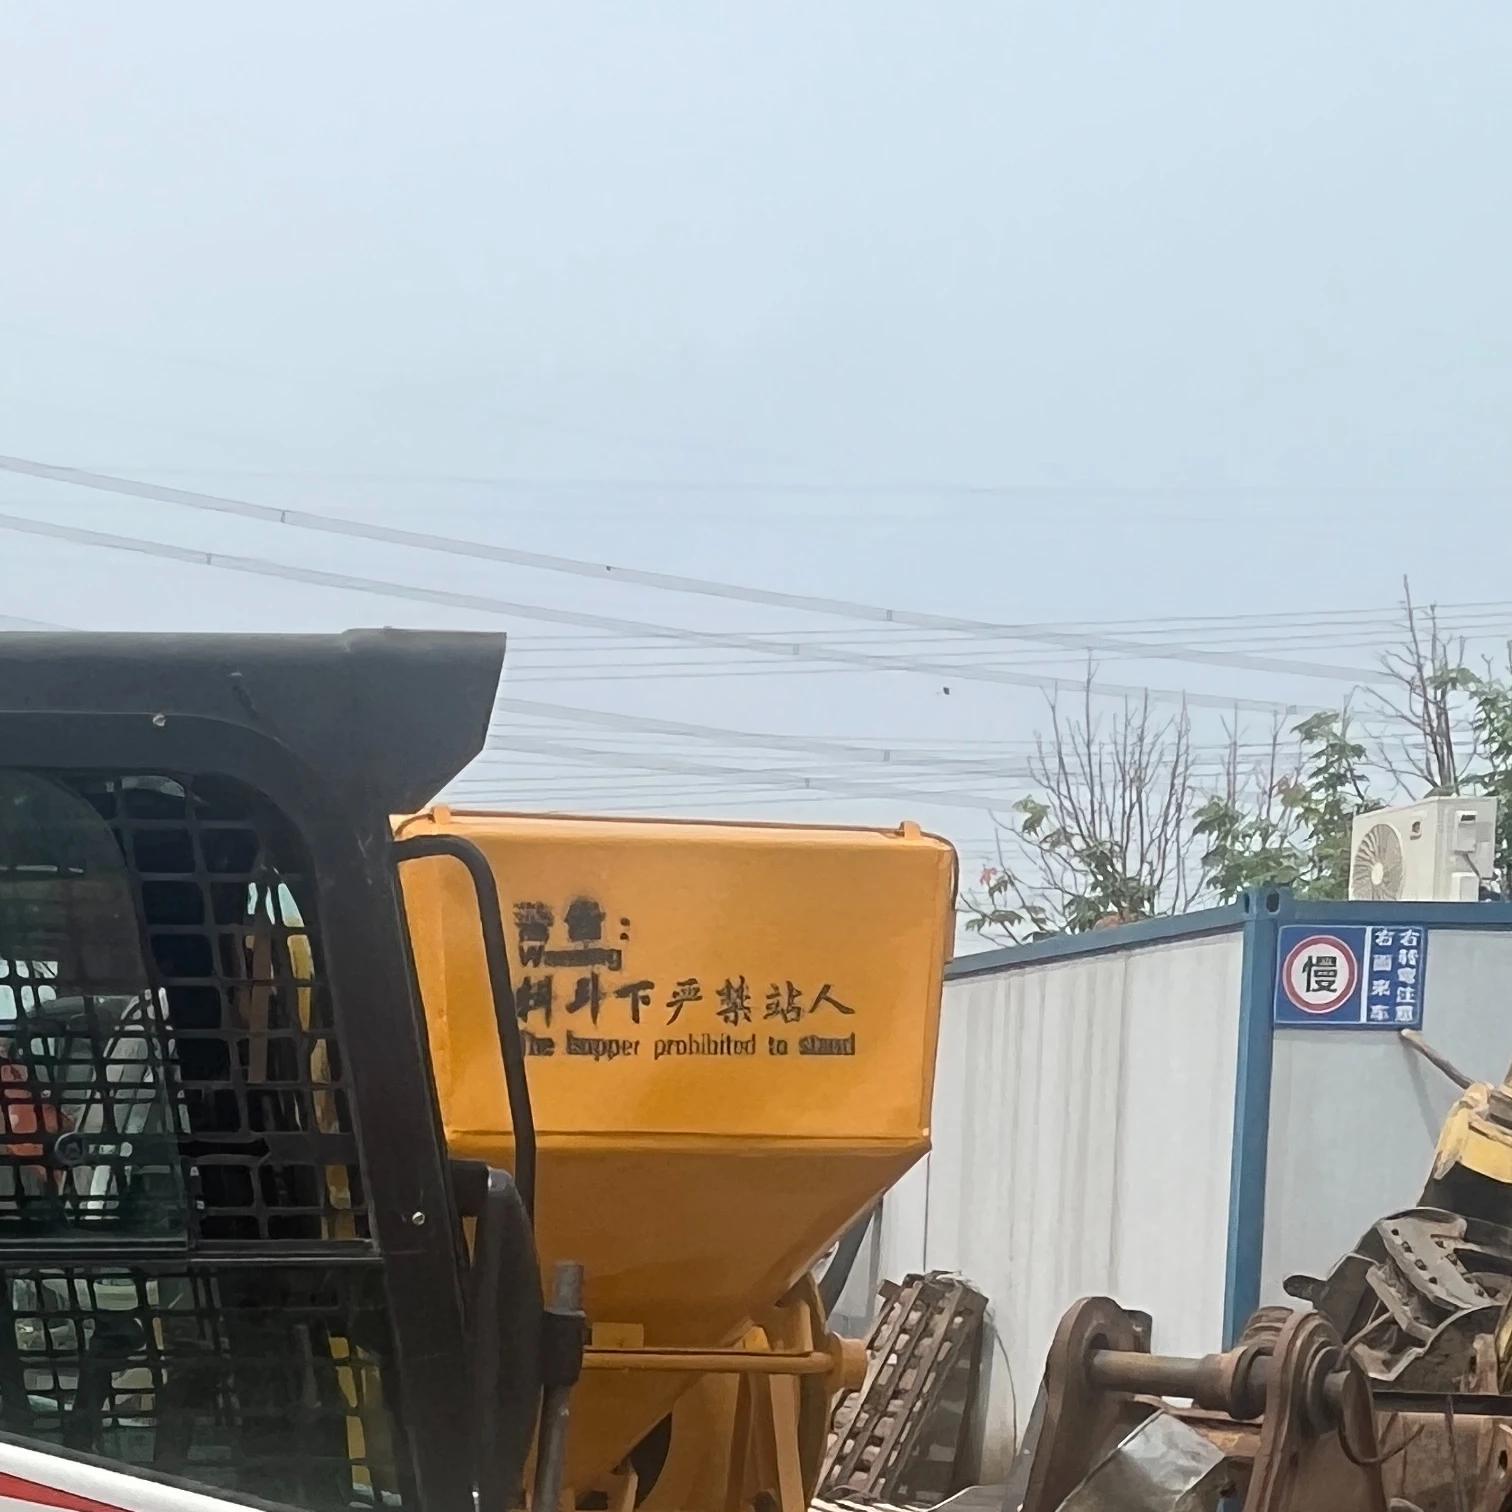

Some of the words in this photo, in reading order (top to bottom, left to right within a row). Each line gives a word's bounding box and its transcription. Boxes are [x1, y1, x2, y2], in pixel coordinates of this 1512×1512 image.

[1302, 955, 1337, 993] 慢
[654, 1031, 756, 1061] prohibited
[769, 1036, 788, 1056] to
